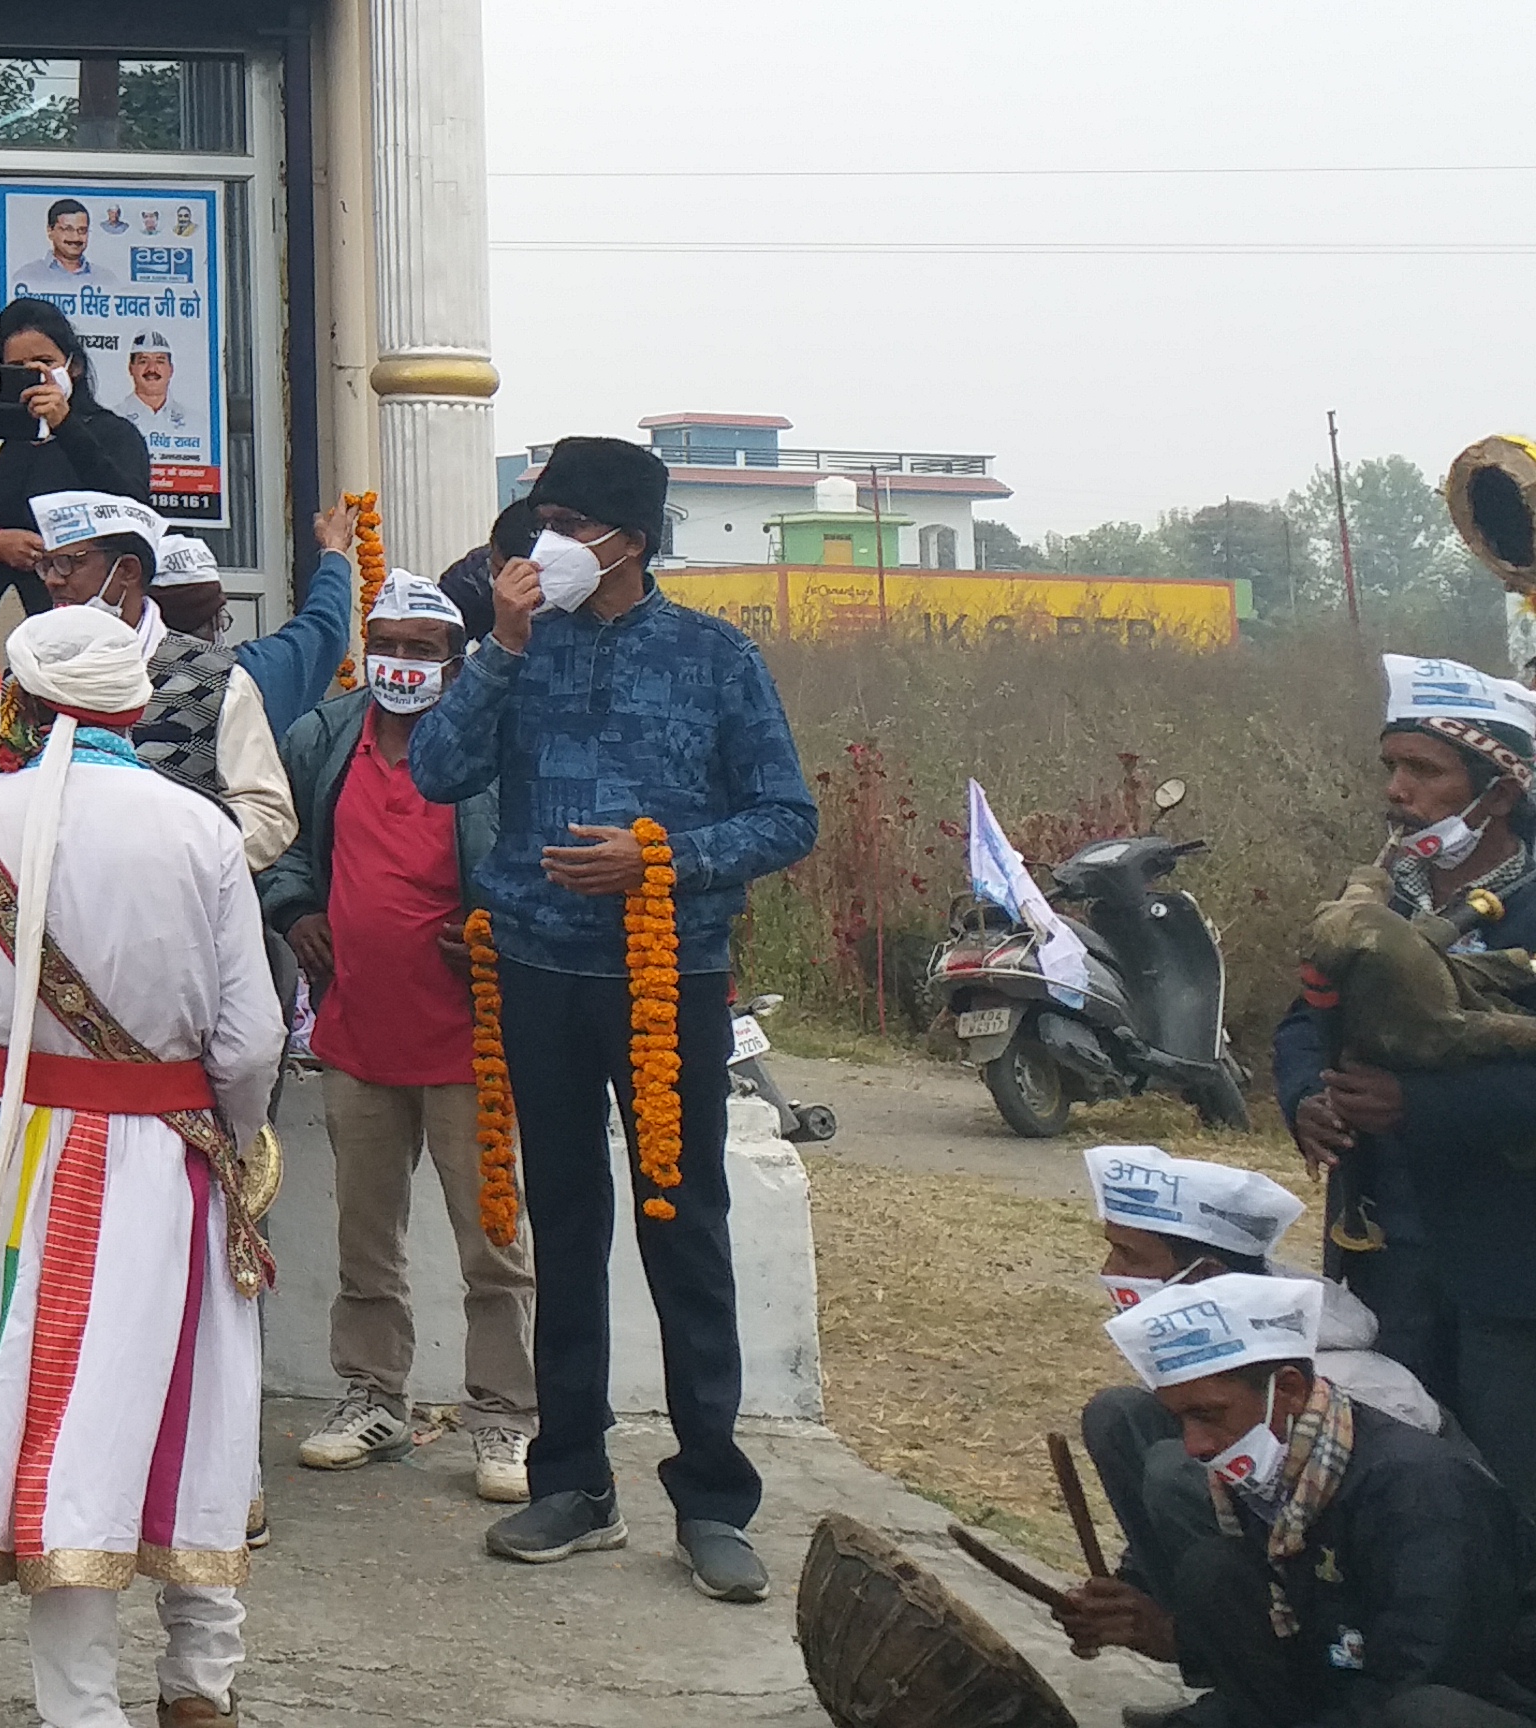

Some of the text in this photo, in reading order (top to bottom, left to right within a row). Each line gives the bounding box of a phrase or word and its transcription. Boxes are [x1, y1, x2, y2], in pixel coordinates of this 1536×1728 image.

[136, 248, 188, 275] aap
[80, 285, 201, 319] सिंह रावत जी को
[94, 504, 121, 519] आम
[163, 548, 194, 571] आम
[1104, 1159, 1188, 1205] आप
[1144, 1300, 1232, 1338] आप
